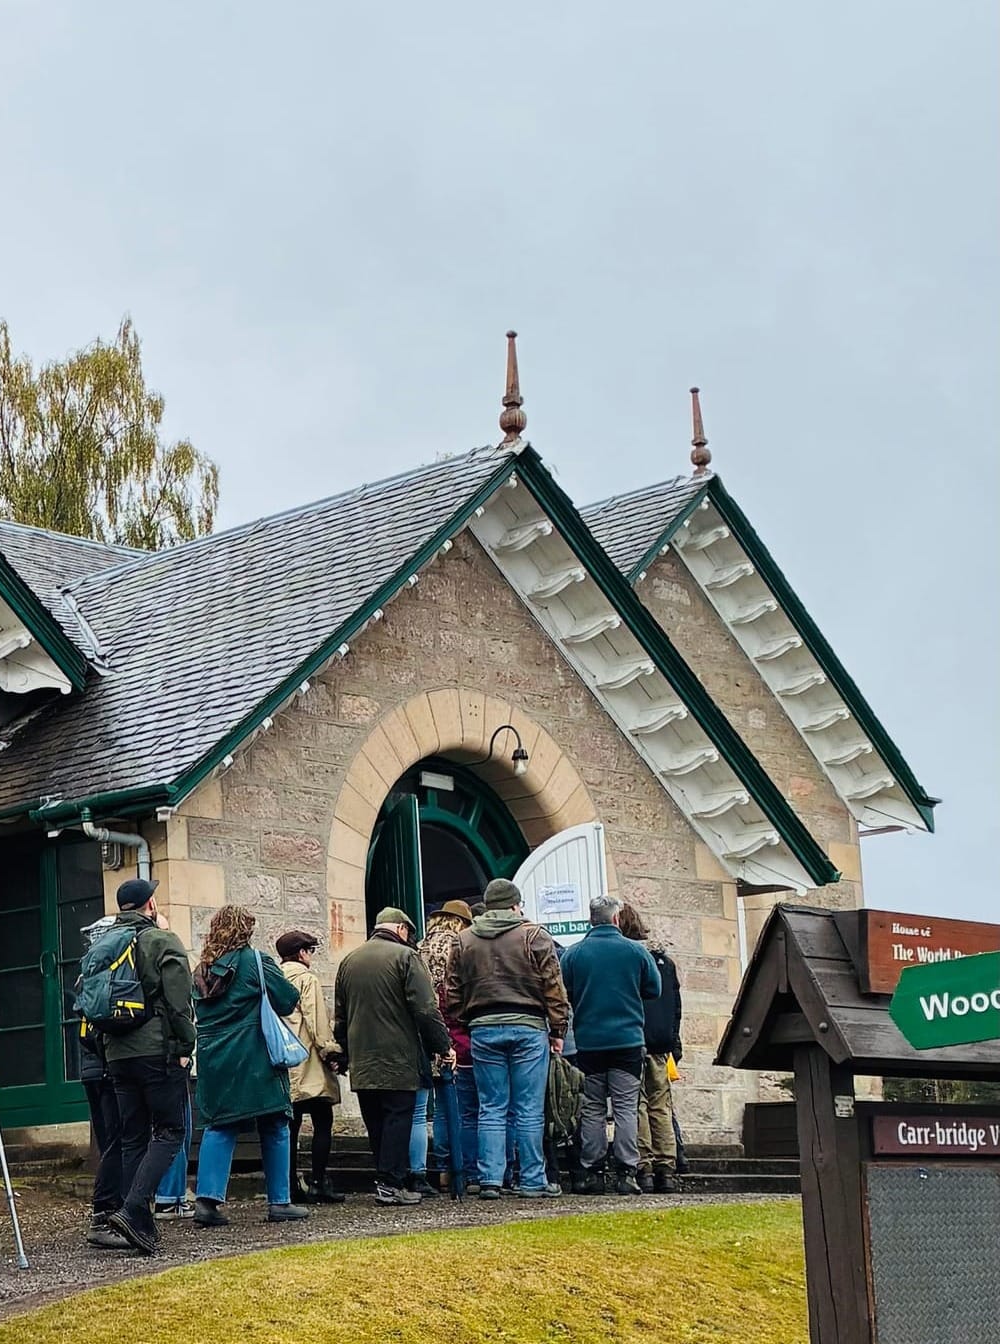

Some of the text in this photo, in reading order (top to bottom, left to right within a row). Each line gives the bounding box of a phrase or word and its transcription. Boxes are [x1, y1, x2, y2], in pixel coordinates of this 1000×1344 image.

[568, 921, 589, 932] bar
[891, 922, 932, 937] Home of
[892, 943, 915, 961] The
[917, 946, 952, 963] World
[897, 1121, 987, 1151] Carr-bridge
